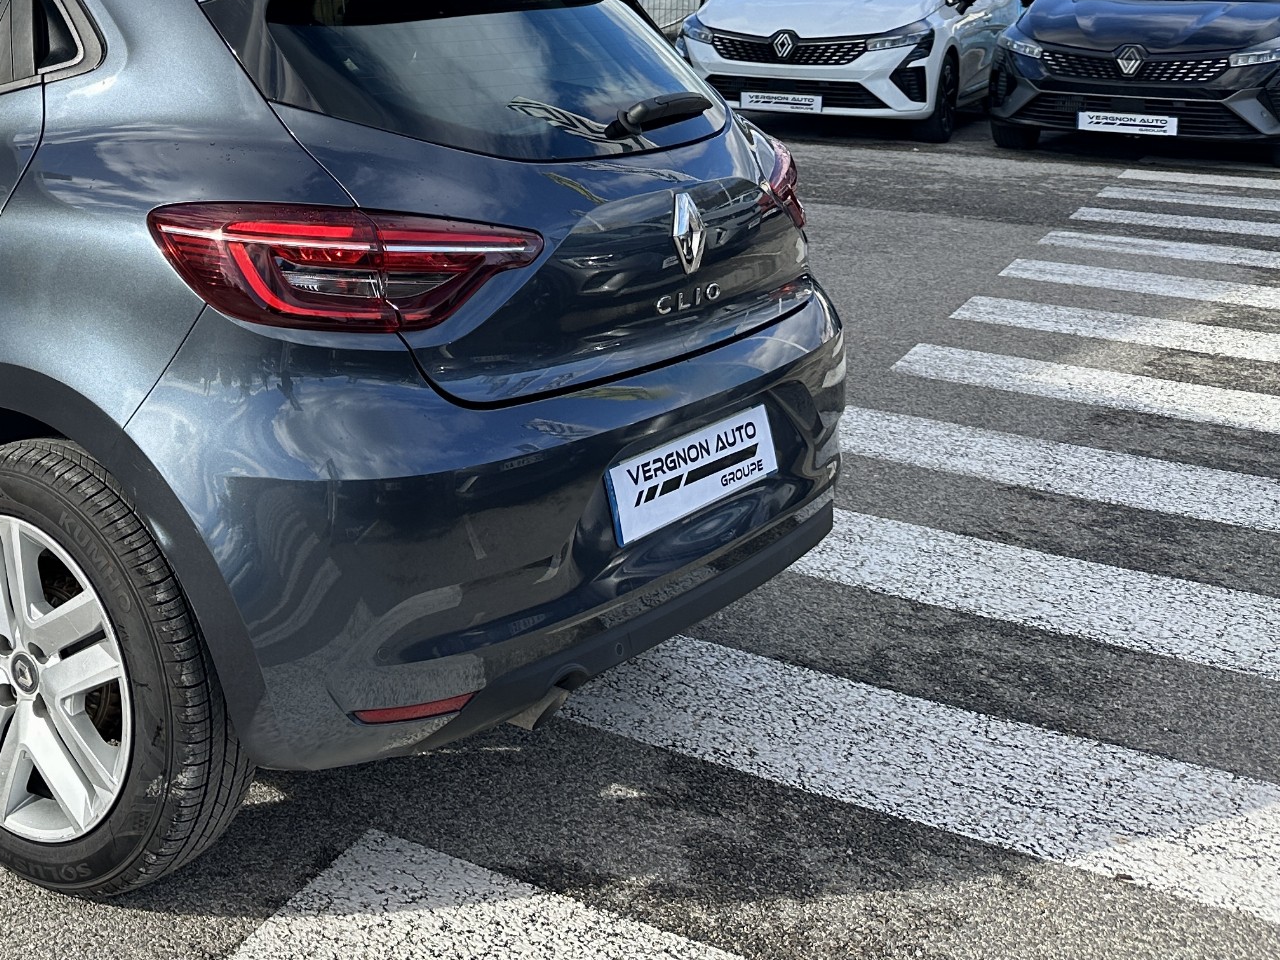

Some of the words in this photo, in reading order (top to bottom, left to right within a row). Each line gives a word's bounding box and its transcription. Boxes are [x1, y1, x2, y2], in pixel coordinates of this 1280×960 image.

[1088, 115, 1136, 123] VERGNON
[656, 282, 721, 315] CLIO
[626, 438, 711, 486] VERGNON
[715, 421, 757, 454] AUTO
[720, 459, 764, 487] GROUPE
[58, 510, 131, 613] KUMHO
